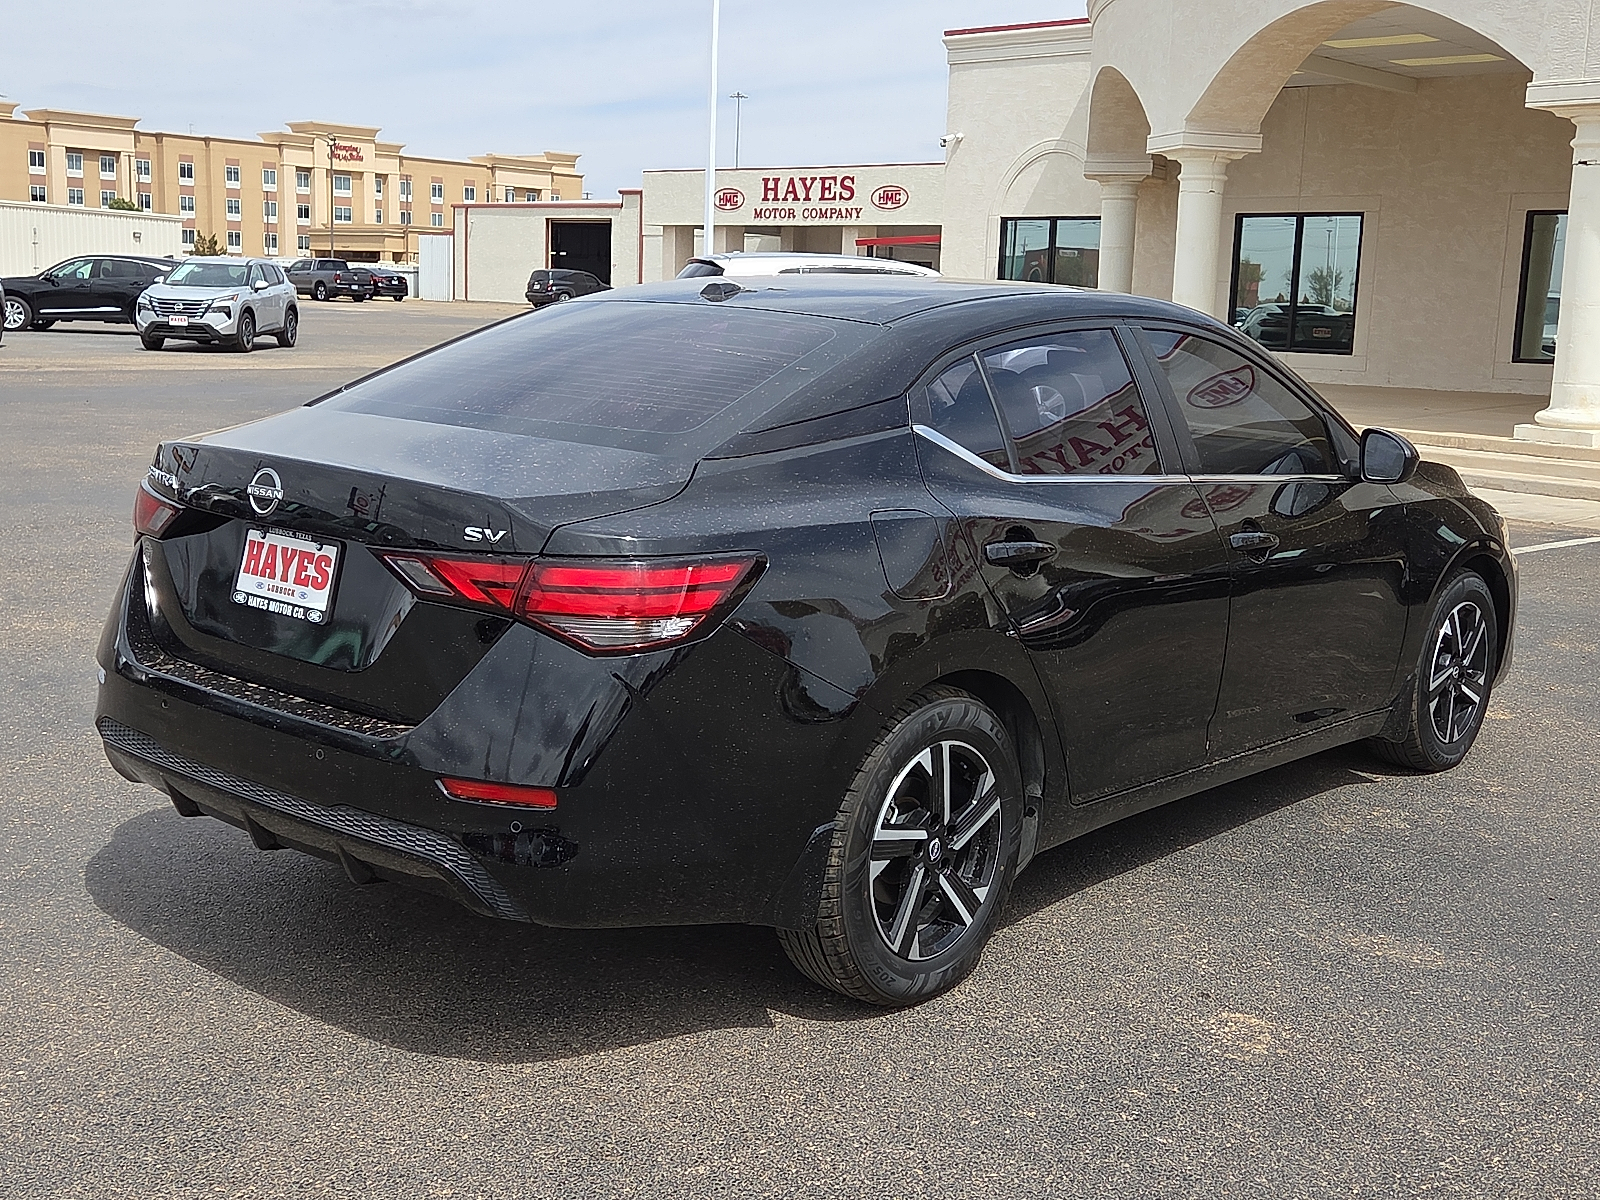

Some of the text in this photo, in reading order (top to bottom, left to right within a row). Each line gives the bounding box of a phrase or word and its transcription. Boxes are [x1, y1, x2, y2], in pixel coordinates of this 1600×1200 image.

[761, 175, 856, 202] HAYES
[718, 192, 739, 206] HMC
[878, 189, 902, 205] HMC
[753, 207, 863, 219] MOTOR COMPANY
[247, 484, 283, 499] NISSAN
[463, 526, 508, 544] SV
[243, 539, 333, 591] HAYES
[267, 583, 296, 598] LUBBOCK
[247, 595, 269, 611] HAYES
[268, 601, 294, 617] MOTOR
[292, 607, 306, 620] CO.
